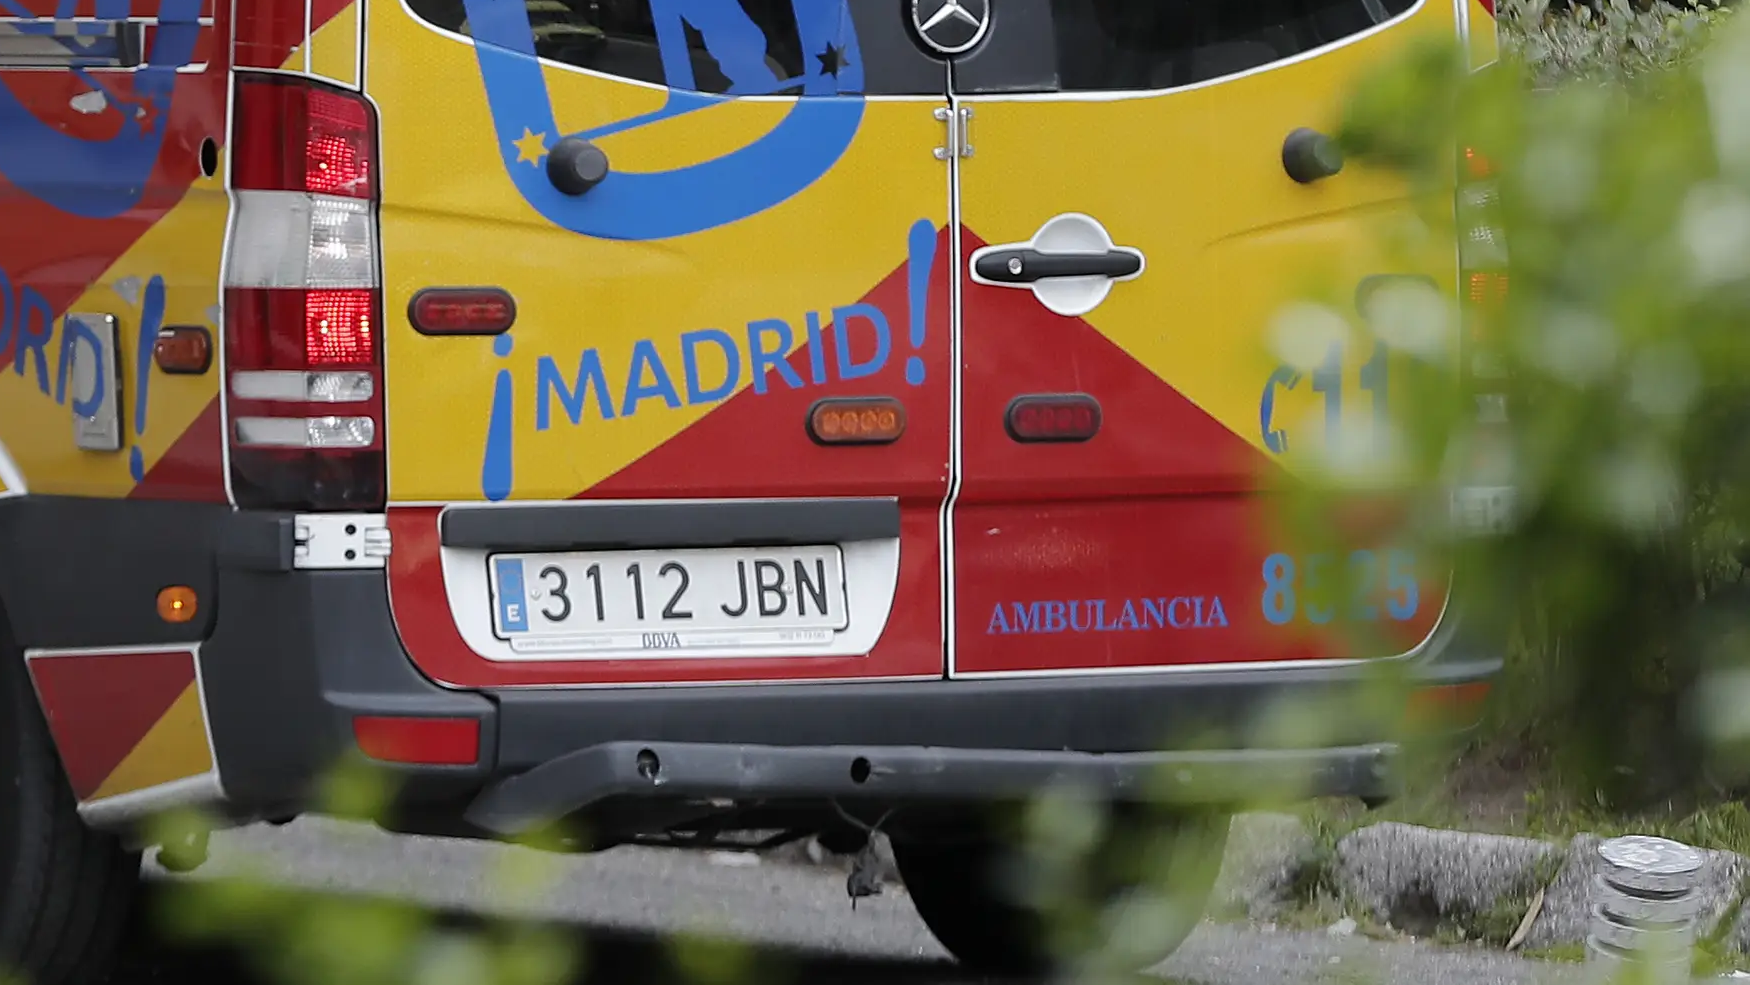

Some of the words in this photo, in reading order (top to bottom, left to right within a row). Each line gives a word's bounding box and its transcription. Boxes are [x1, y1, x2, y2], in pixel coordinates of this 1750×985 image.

[507, 604, 520, 623] E
[538, 562, 694, 622] 3112
[720, 558, 829, 618] JBN
[987, 596, 1229, 635] AMBULANCIA
